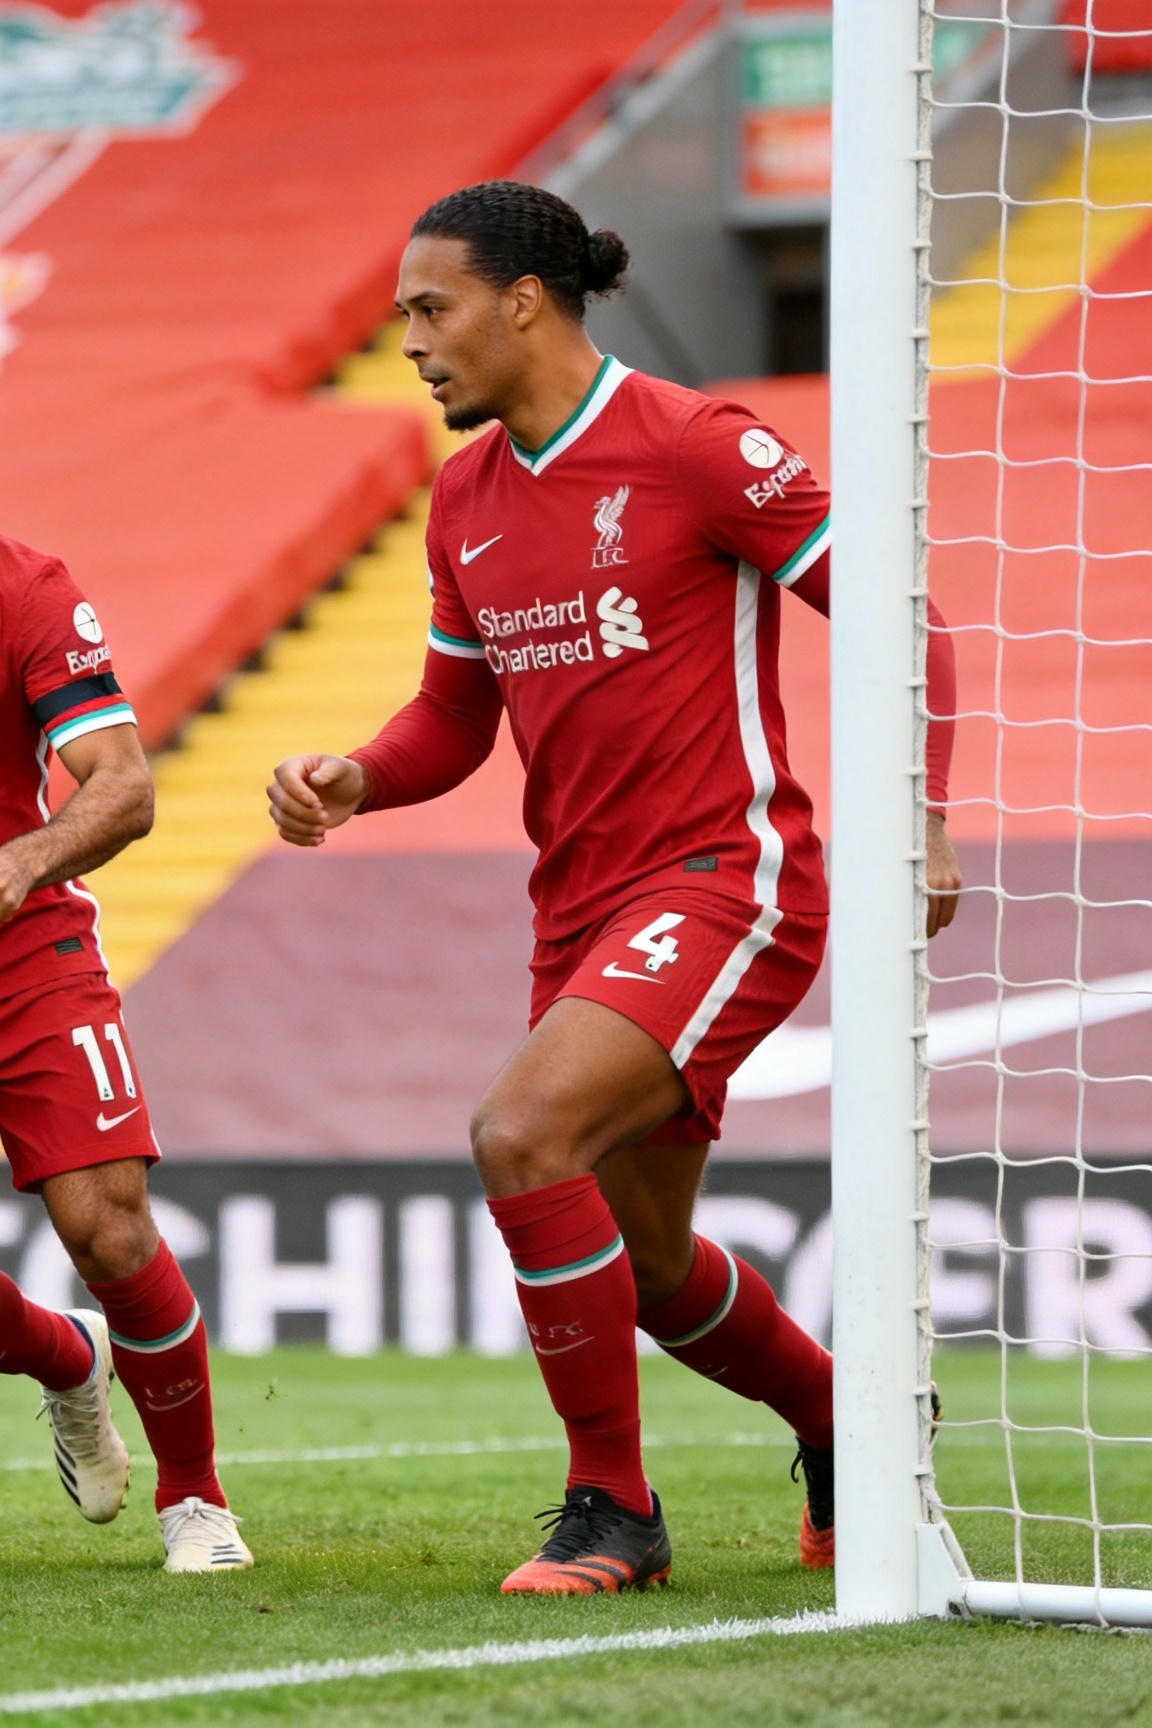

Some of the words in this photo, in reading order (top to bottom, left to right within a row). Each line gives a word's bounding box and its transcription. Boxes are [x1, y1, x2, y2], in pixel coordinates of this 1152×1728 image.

[478, 590, 586, 638] Standard
[485, 630, 594, 674] Chartered
[627, 912, 686, 972] 4
[72, 1023, 136, 1101] 11
